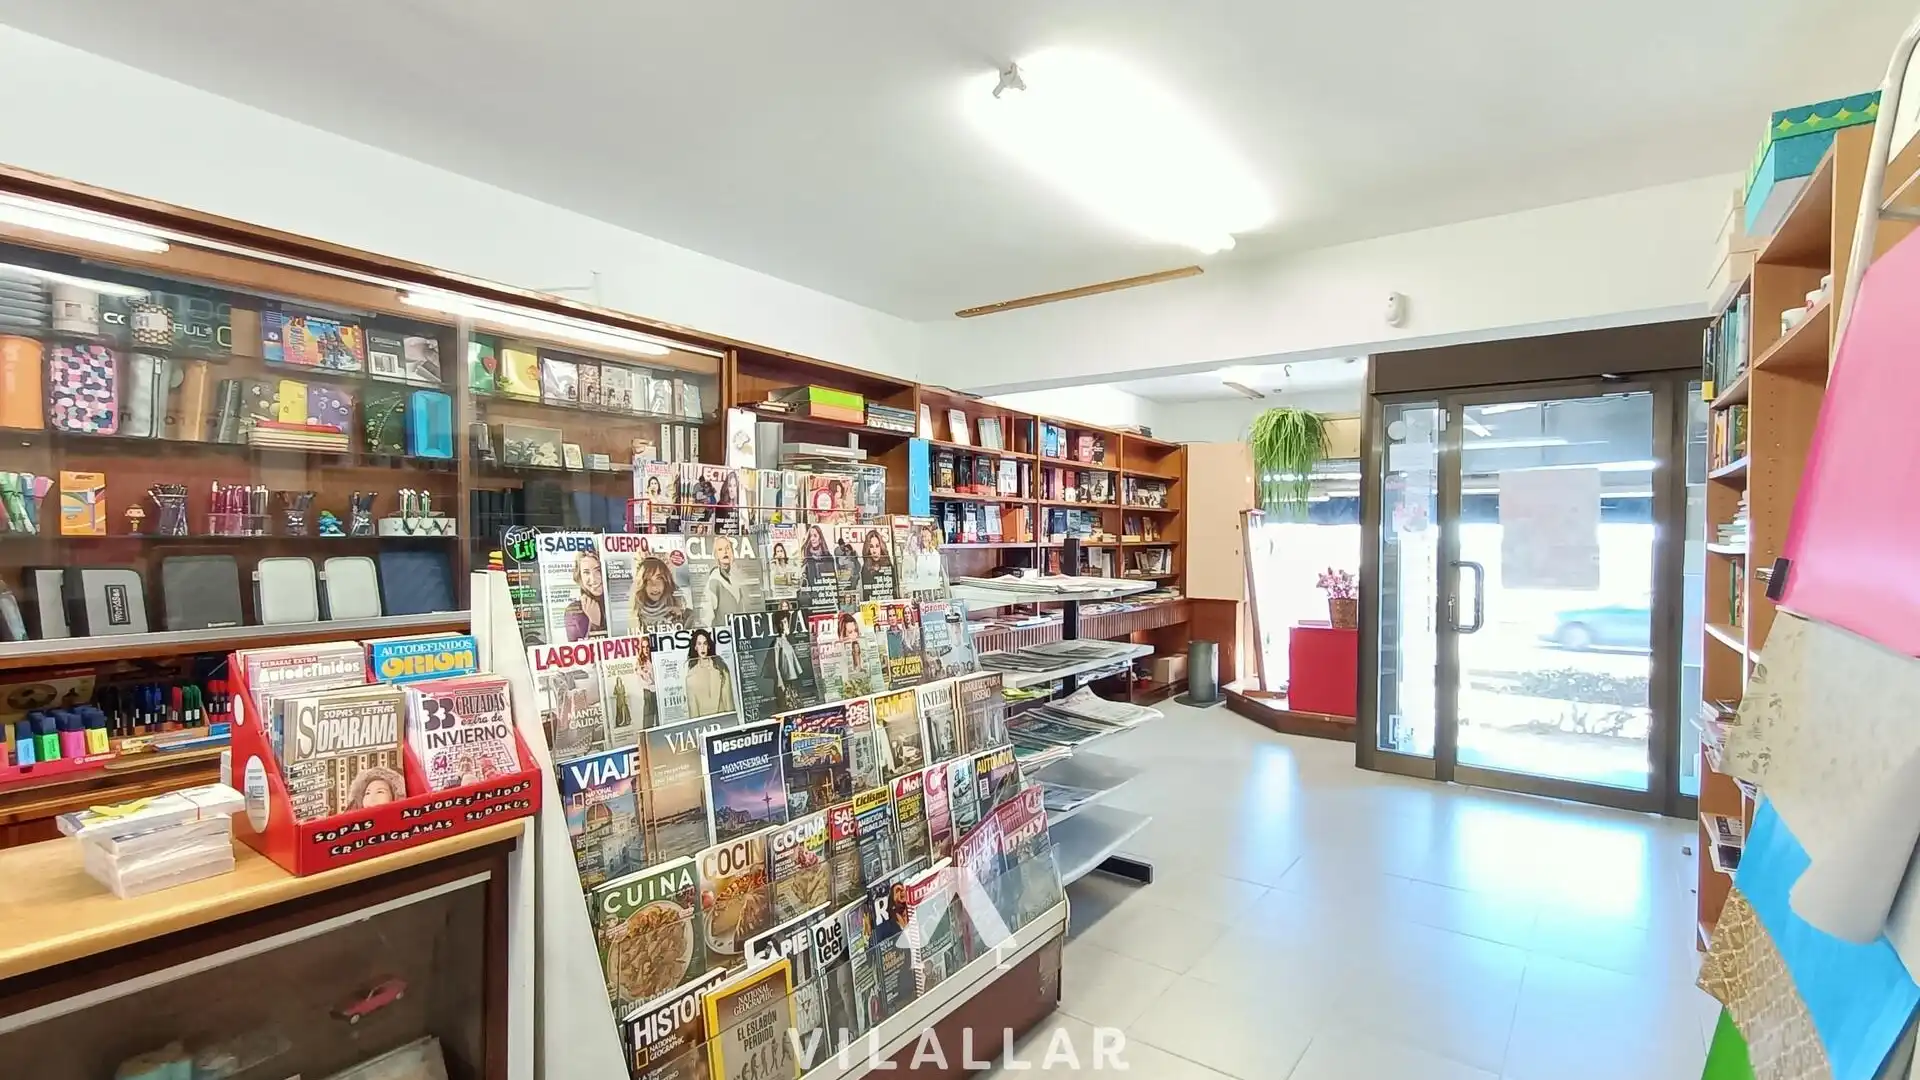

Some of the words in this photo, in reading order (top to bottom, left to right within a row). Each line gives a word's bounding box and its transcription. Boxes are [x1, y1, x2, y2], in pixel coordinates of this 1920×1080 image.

[506, 528, 536, 547] Sport
[514, 539, 537, 560] Lif
[544, 537, 596, 552] SABER
[604, 536, 649, 553] CUERPO
[685, 536, 756, 560] CLRA
[381, 639, 473, 657] AUTODEFINIDOS
[258, 657, 361, 683] Autodefinidos
[323, 708, 355, 720] SOPAS
[361, 705, 396, 717] LETRAS
[422, 697, 456, 732] 33
[455, 692, 506, 716] CRUZADAS
[460, 714, 489, 727] extra
[491, 712, 504, 723] de
[567, 708, 605, 721] MANTAS
[297, 704, 399, 759] SOPARAMA
[426, 724, 508, 750] INVIERNO
[713, 728, 774, 755] Descobrir
[570, 751, 641, 790] VIAJE
[402, 780, 531, 819] AUTODEFINIDOS
[465, 801, 531, 821] SUDOKUS
[856, 789, 888, 807] Ciclismo
[315, 819, 375, 843] SOPAS
[331, 820, 453, 856] CRUCIGRAMAS
[773, 816, 825, 853] COCINA
[603, 867, 694, 914] CUINA
[815, 917, 842, 948] Qué
[818, 936, 844, 964] leer
[737, 1026, 746, 1041] EL
[746, 1009, 778, 1035] ESLABÓN
[743, 1025, 775, 1053] PERDIDO
